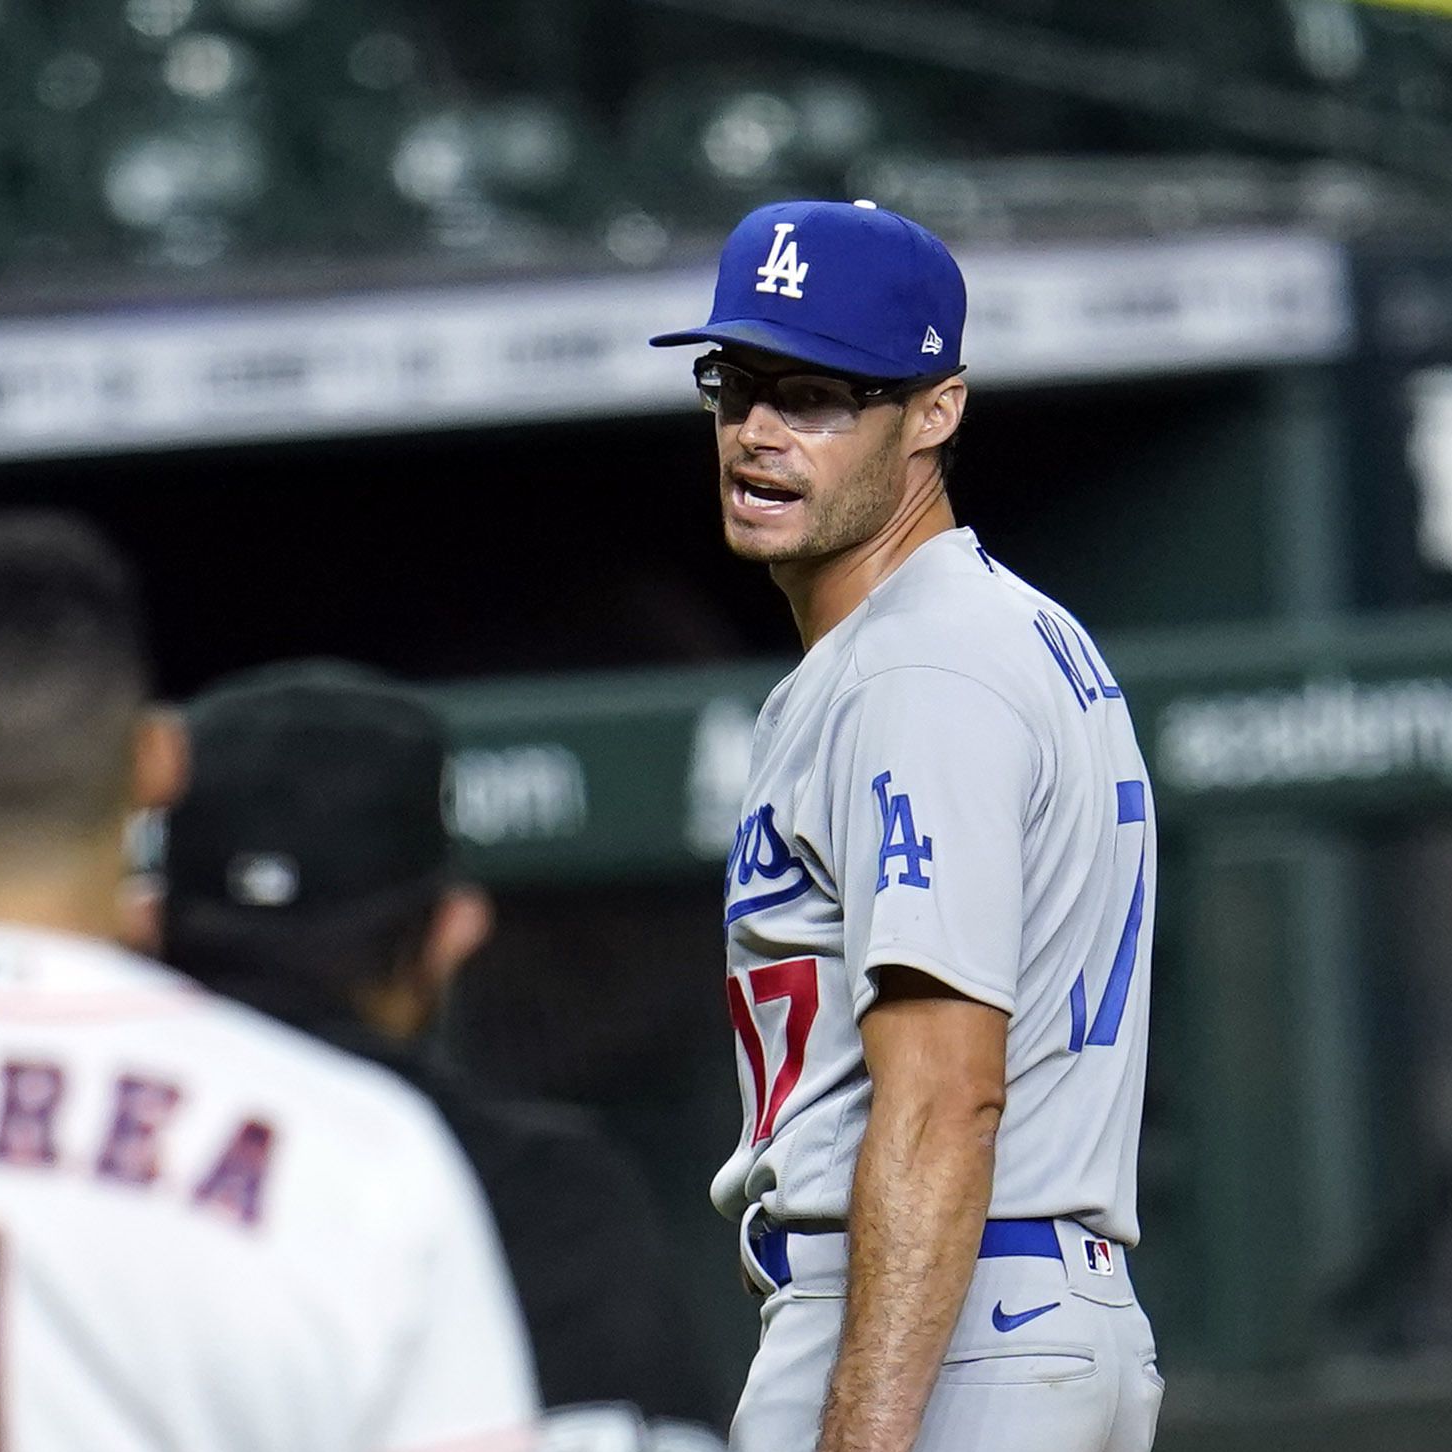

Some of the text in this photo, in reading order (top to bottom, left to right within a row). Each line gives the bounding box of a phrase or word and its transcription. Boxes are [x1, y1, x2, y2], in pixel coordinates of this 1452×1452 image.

[755, 222, 809, 299] LA
[871, 770, 933, 894] LA
[727, 957, 820, 1148] 17
